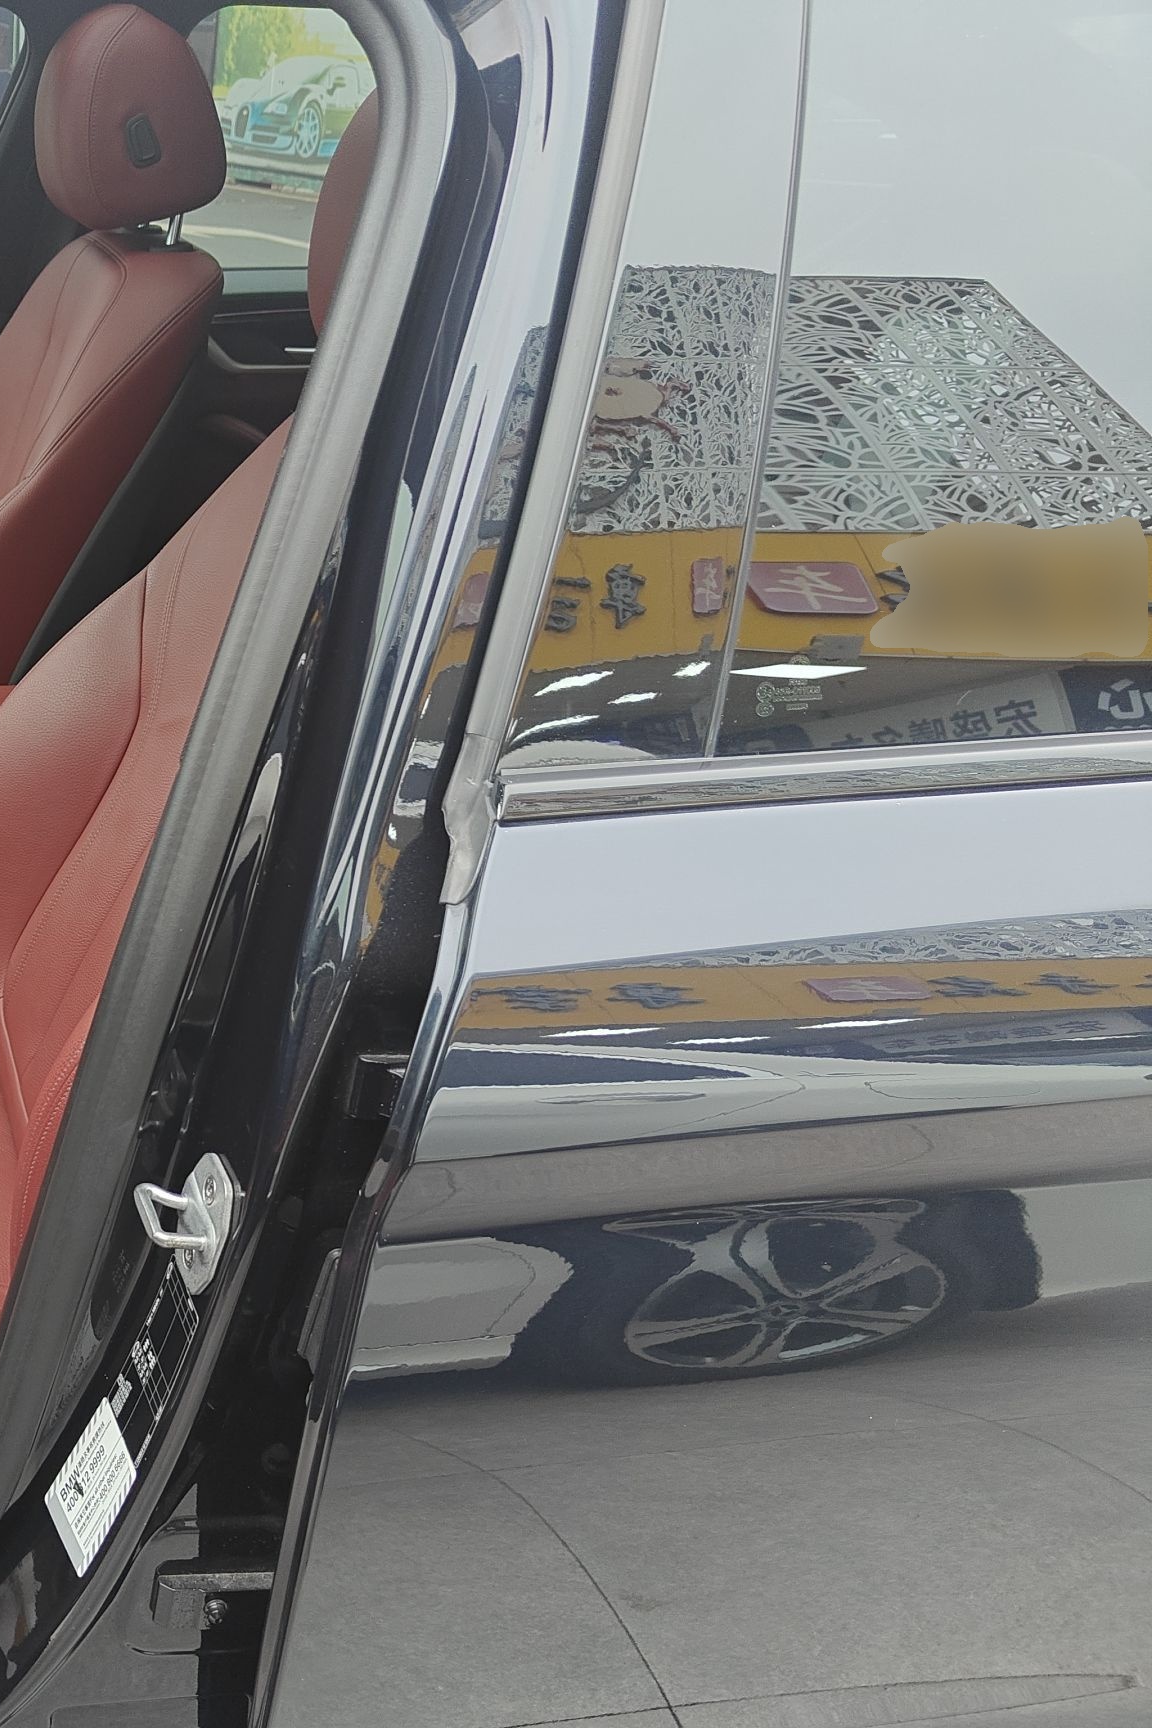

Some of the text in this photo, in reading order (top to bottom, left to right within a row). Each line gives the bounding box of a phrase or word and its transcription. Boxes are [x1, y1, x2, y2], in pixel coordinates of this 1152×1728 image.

[59, 1466, 80, 1502] BMW
[66, 1488, 79, 1512] 400
[88, 1444, 105, 1474] 9999
